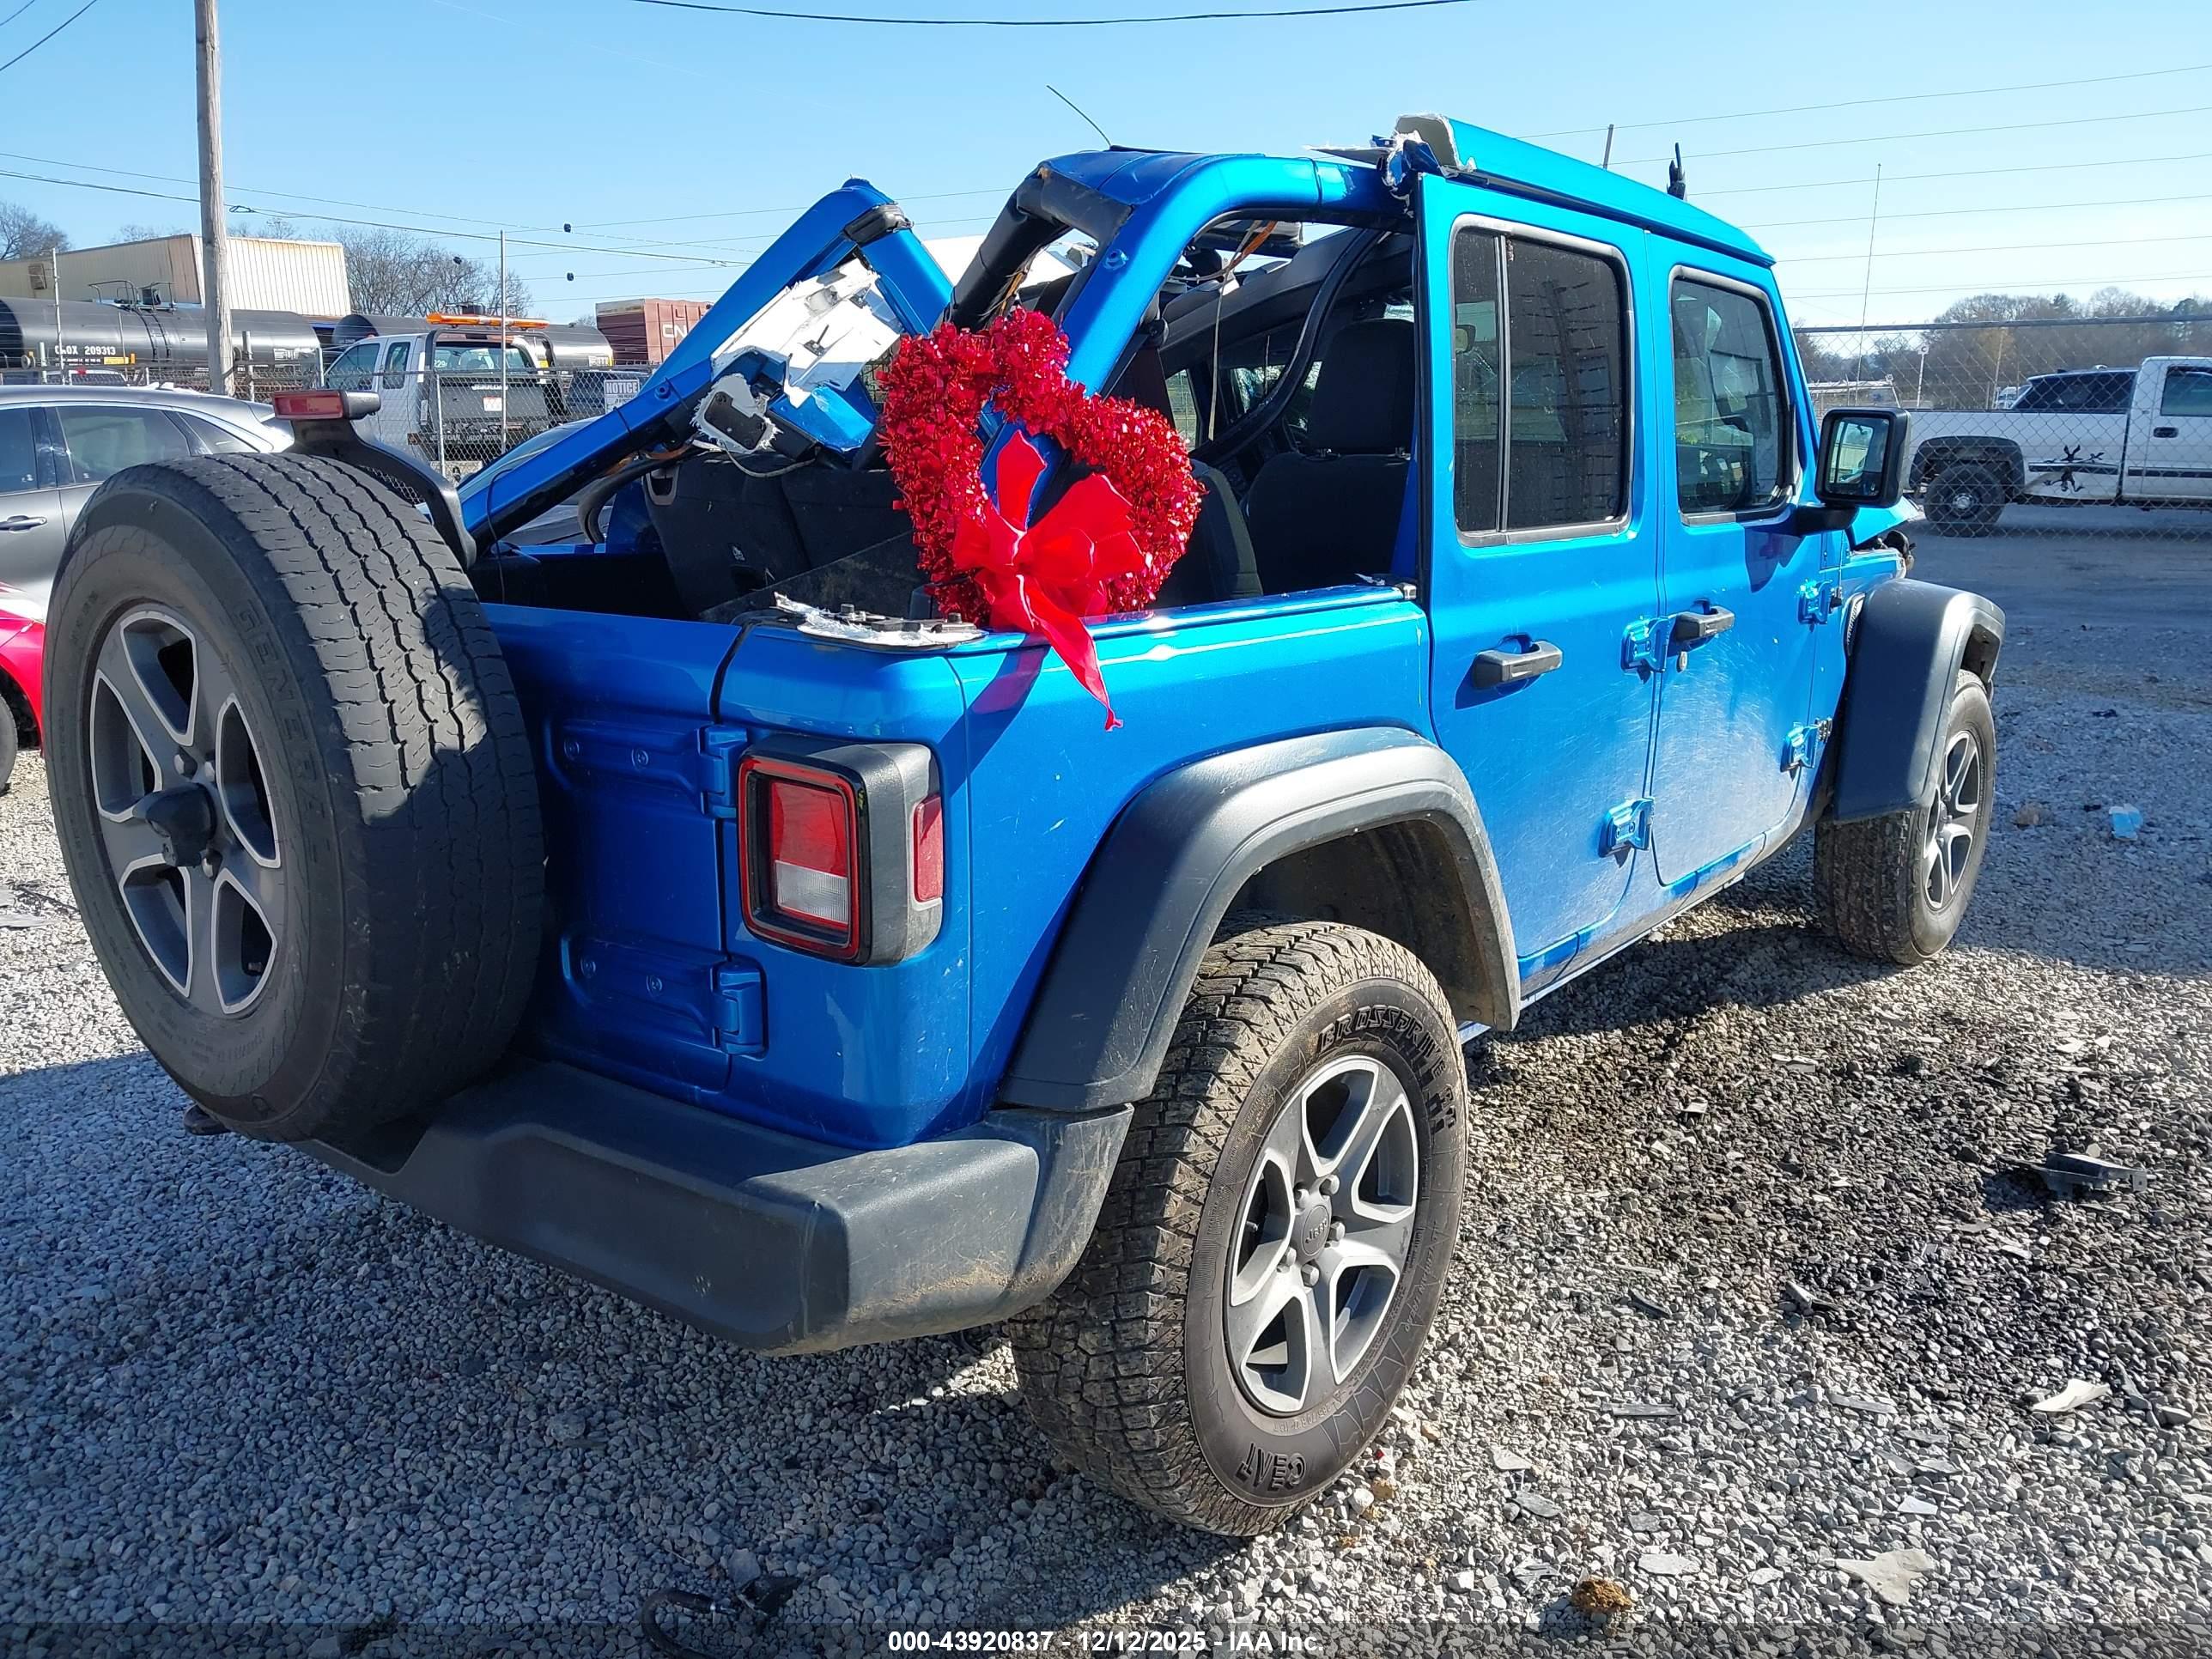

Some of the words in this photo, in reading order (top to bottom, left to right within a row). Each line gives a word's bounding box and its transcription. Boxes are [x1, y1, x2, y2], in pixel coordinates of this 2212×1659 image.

[662, 324, 688, 338] CN
[84, 346, 116, 356] 209313
[605, 381, 638, 394] NOTICE
[1236, 1442, 1306, 1491] CEAT
